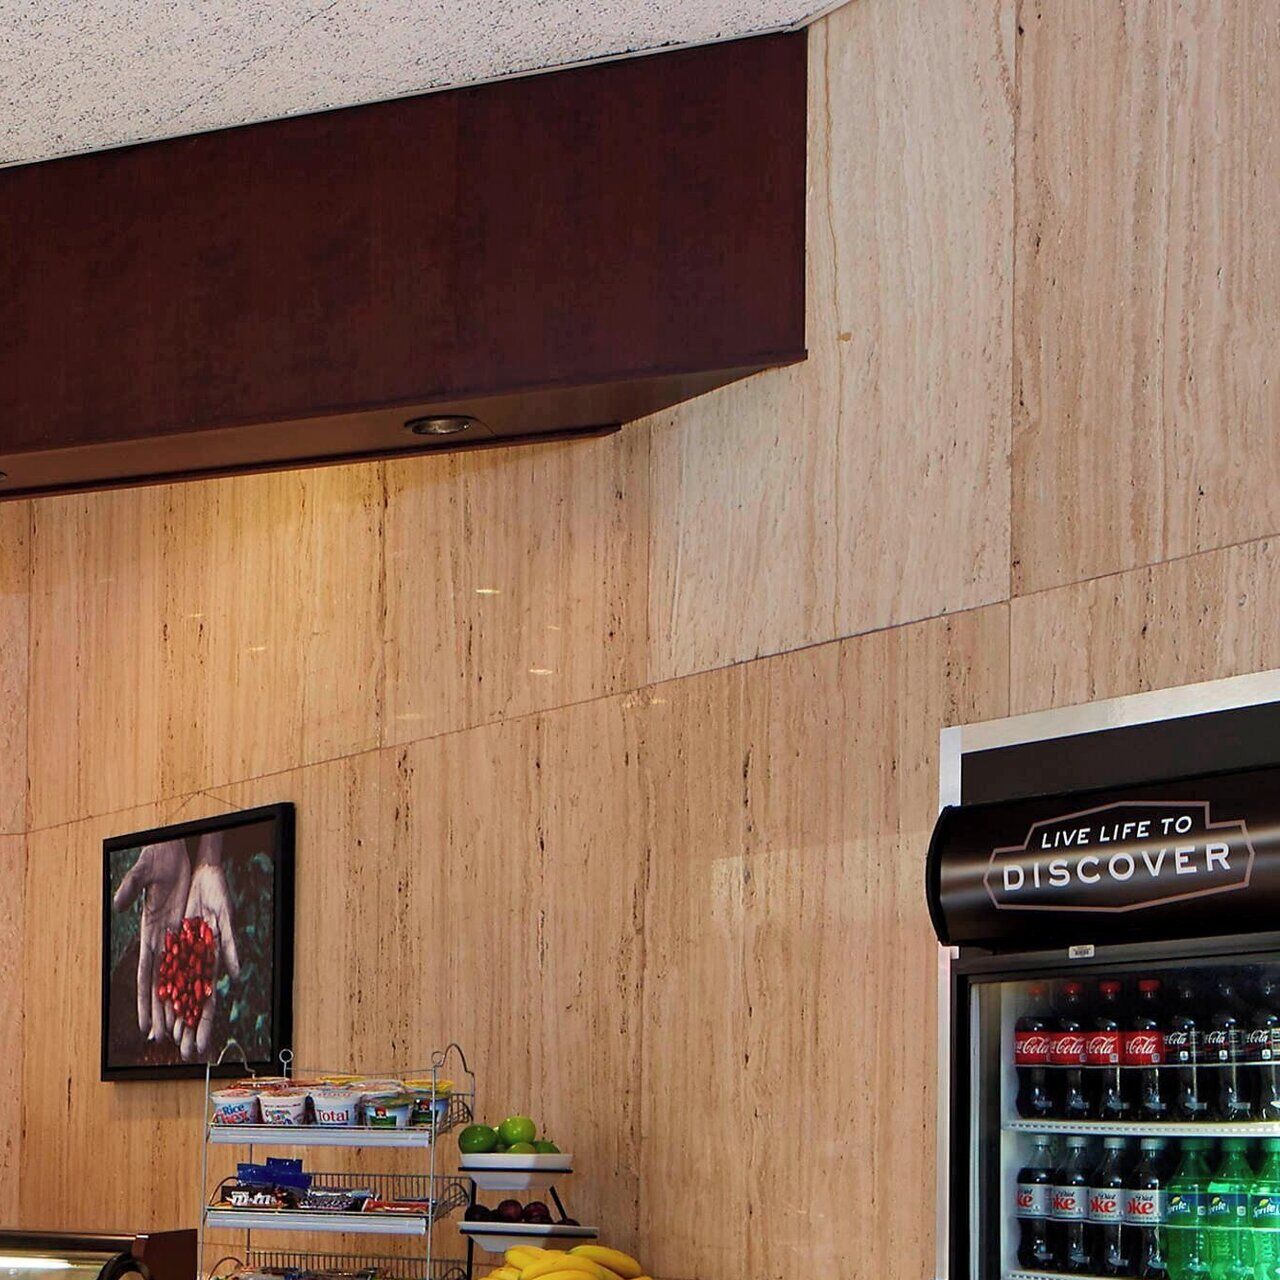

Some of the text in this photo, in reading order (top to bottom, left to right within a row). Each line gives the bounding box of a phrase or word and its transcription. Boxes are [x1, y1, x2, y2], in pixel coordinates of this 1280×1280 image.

[1041, 815, 1193, 849] LIVE LIFE TO
[1002, 842, 1231, 892] DISCOVER
[222, 1103, 245, 1116] Rice
[317, 1110, 350, 1122] Total
